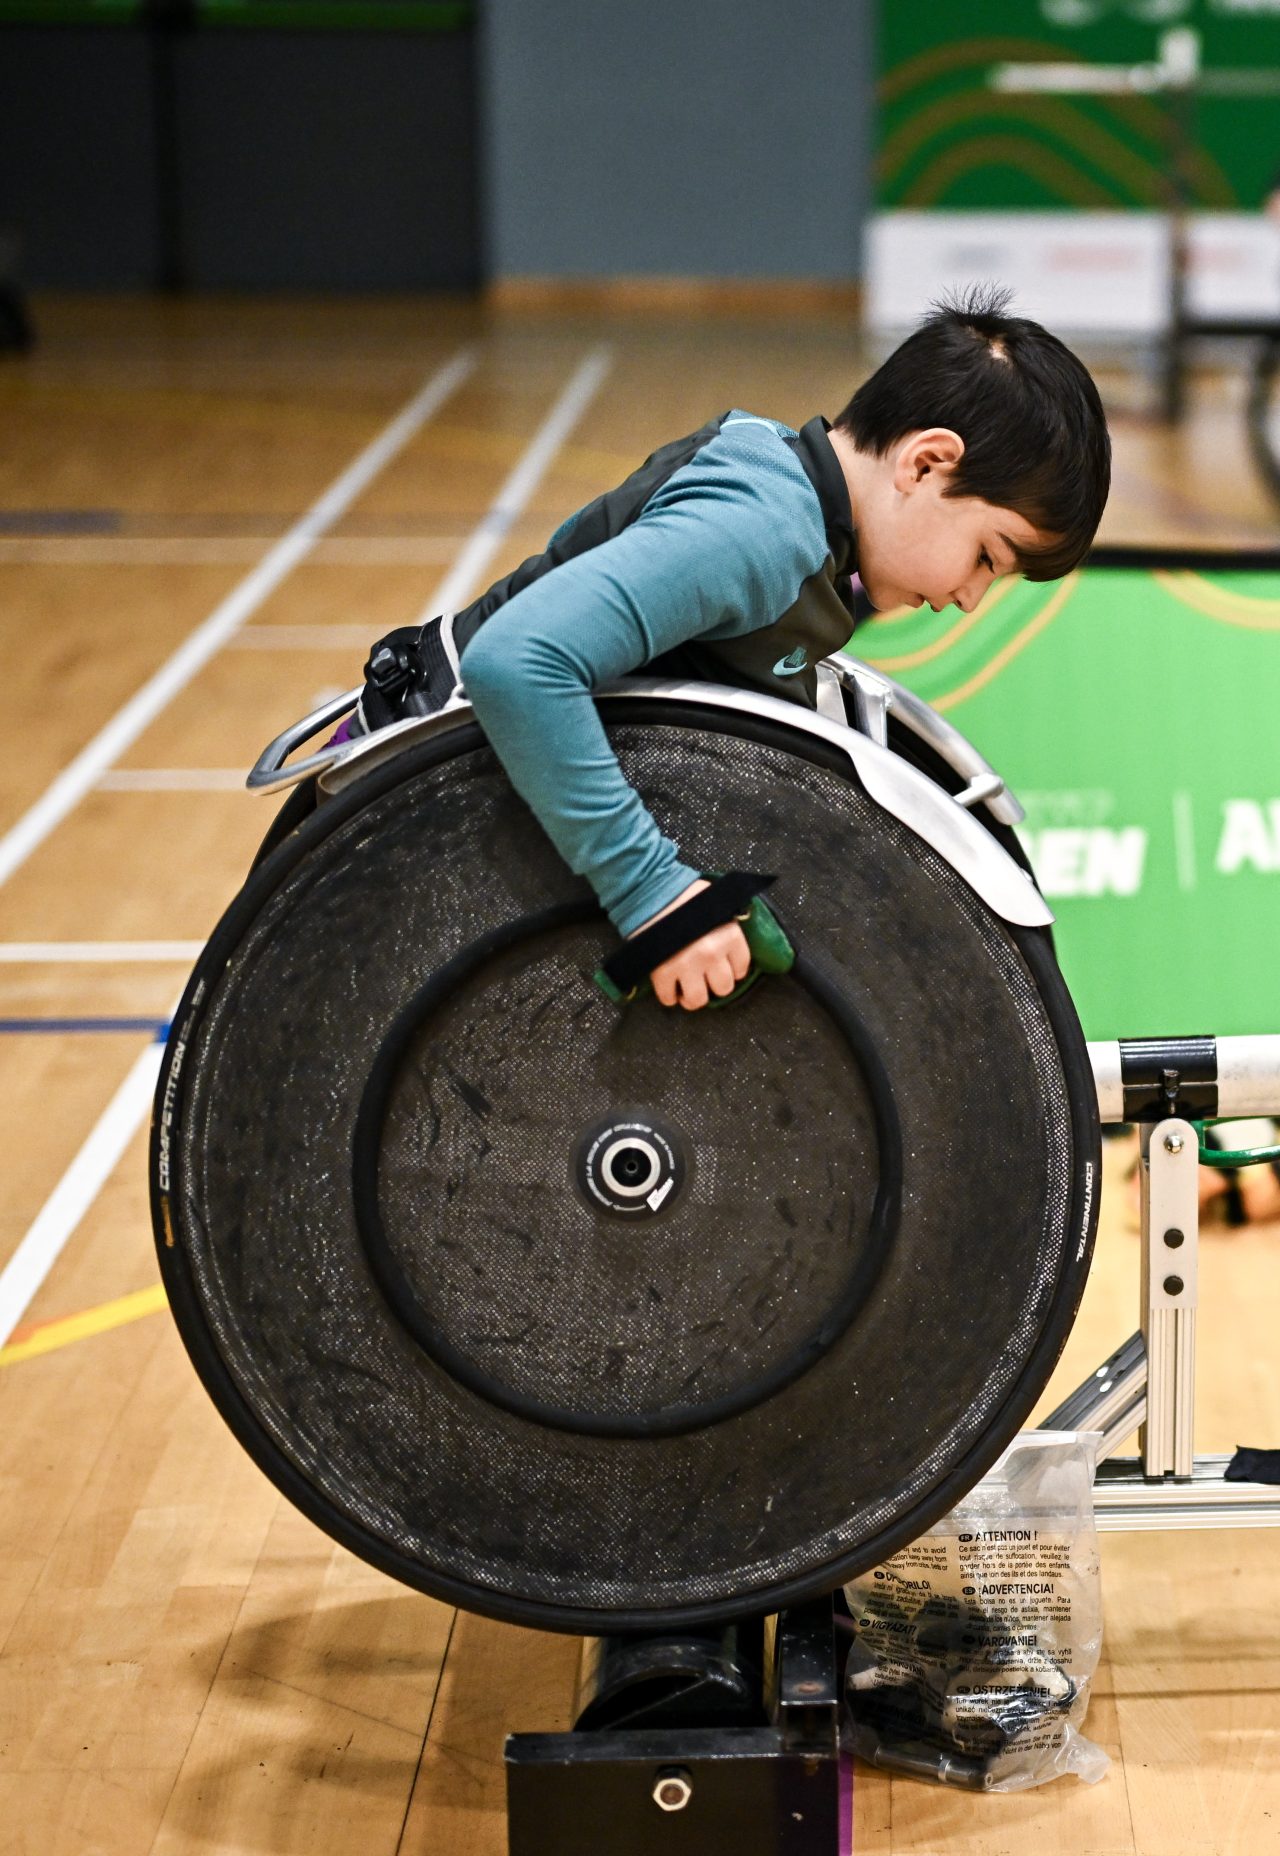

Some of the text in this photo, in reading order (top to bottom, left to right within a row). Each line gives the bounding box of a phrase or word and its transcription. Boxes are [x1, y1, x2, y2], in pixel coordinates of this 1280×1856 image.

[159, 1041, 186, 1191] COMPETITION
[1076, 1161, 1093, 1263] CONTINENTAL
[975, 1530, 1031, 1542] ATTENTION
